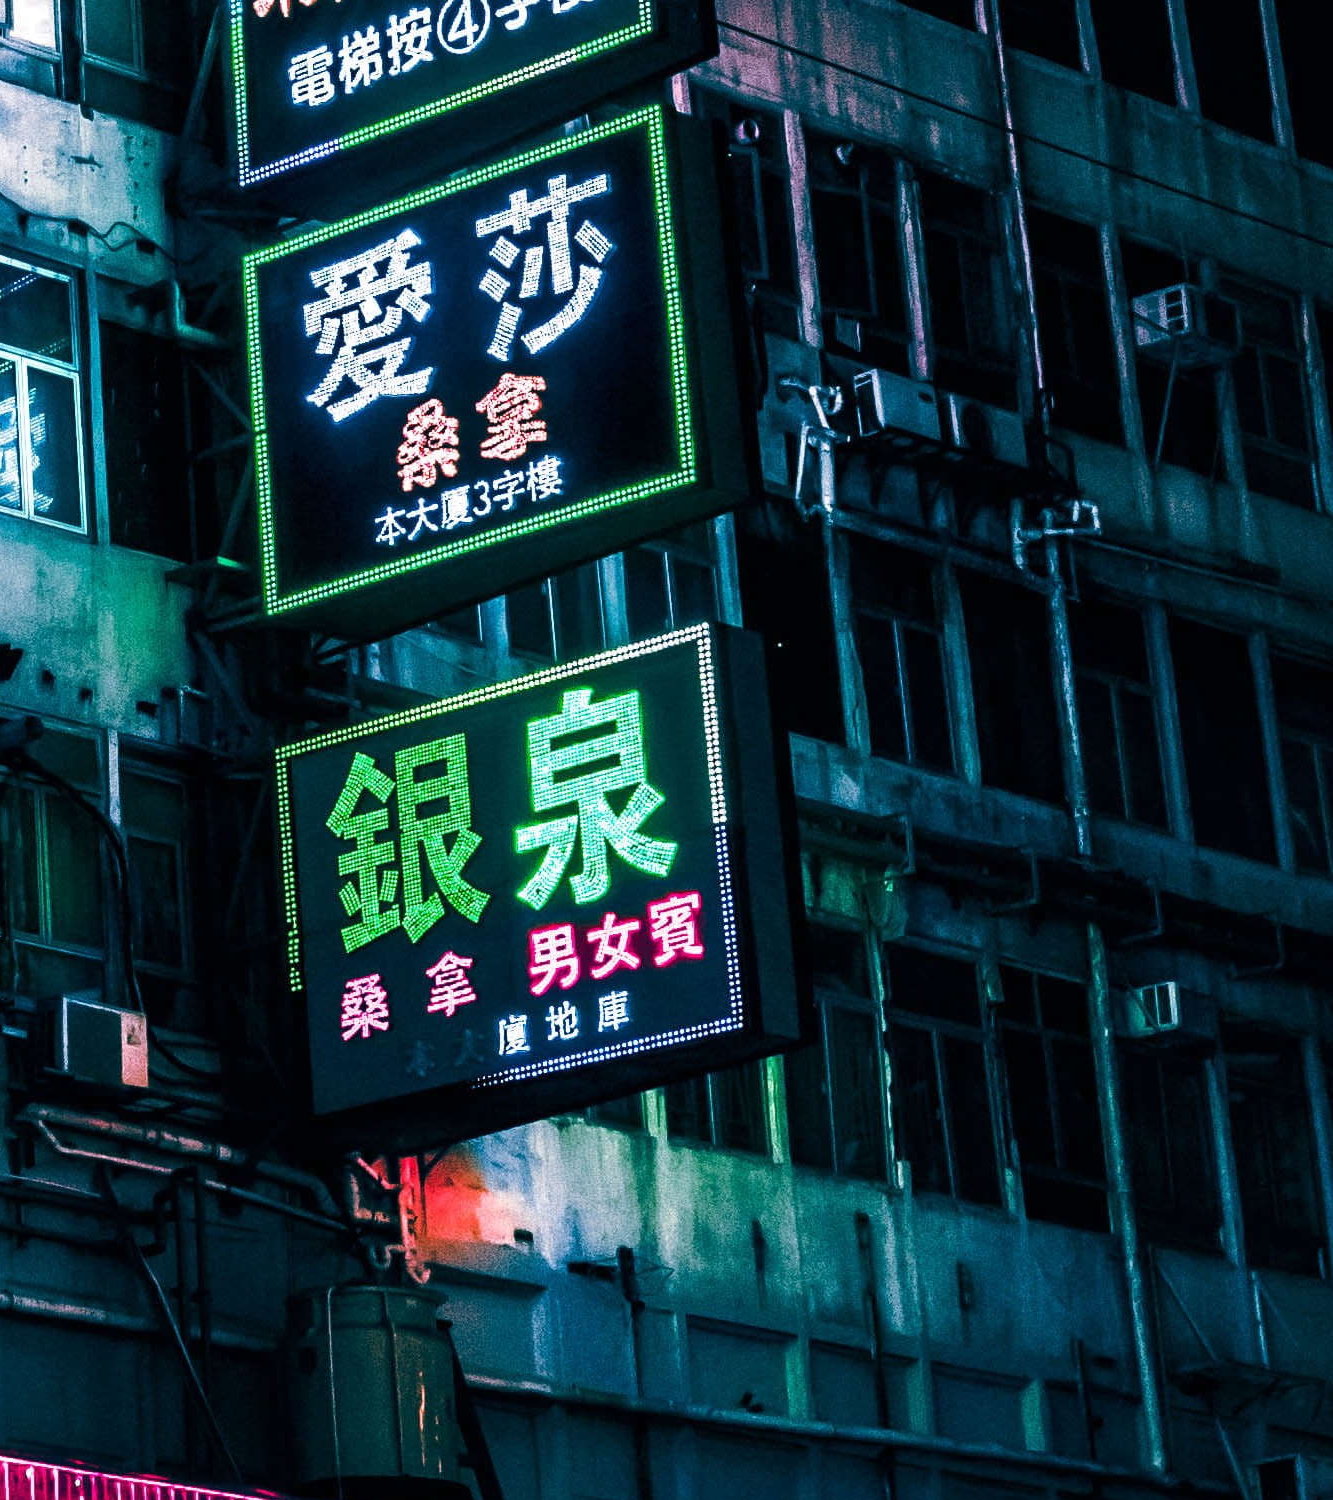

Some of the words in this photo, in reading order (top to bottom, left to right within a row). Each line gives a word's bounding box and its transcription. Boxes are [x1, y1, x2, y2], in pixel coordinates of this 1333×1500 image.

[302, 173, 618, 423] 愛莎
[374, 454, 565, 546] 本大廈3字樓
[396, 371, 548, 493] 桑拿
[325, 686, 679, 954] 銀泉
[340, 950, 477, 1041] 桑拿
[529, 891, 705, 997] 男女賓
